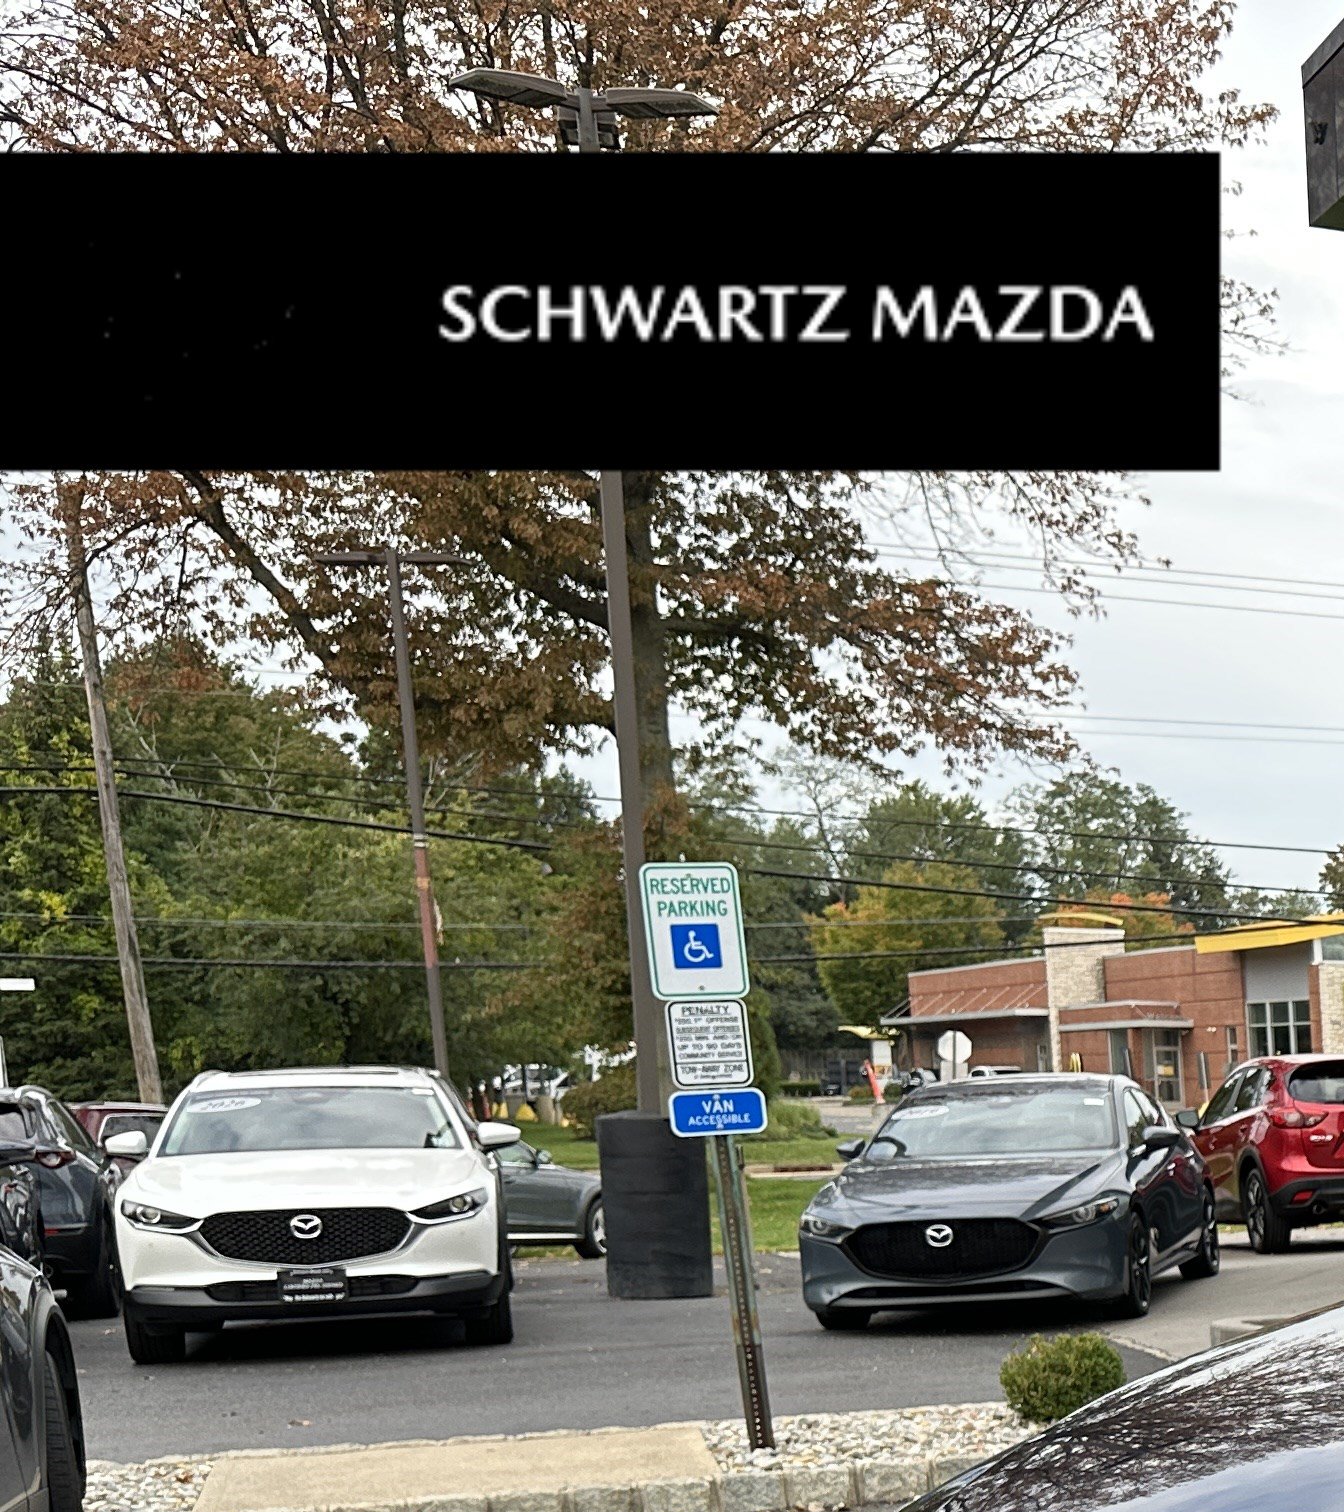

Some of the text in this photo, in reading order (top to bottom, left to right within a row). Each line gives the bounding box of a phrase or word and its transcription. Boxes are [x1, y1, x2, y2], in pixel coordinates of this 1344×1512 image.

[649, 877, 731, 895] RESERVED
[657, 900, 728, 917] PARKING
[681, 1004, 729, 1015] PENALTY
[724, 1064, 745, 1073] ZONE
[701, 1099, 735, 1114] VAN
[688, 1112, 751, 1126] ACCESSIBLE
